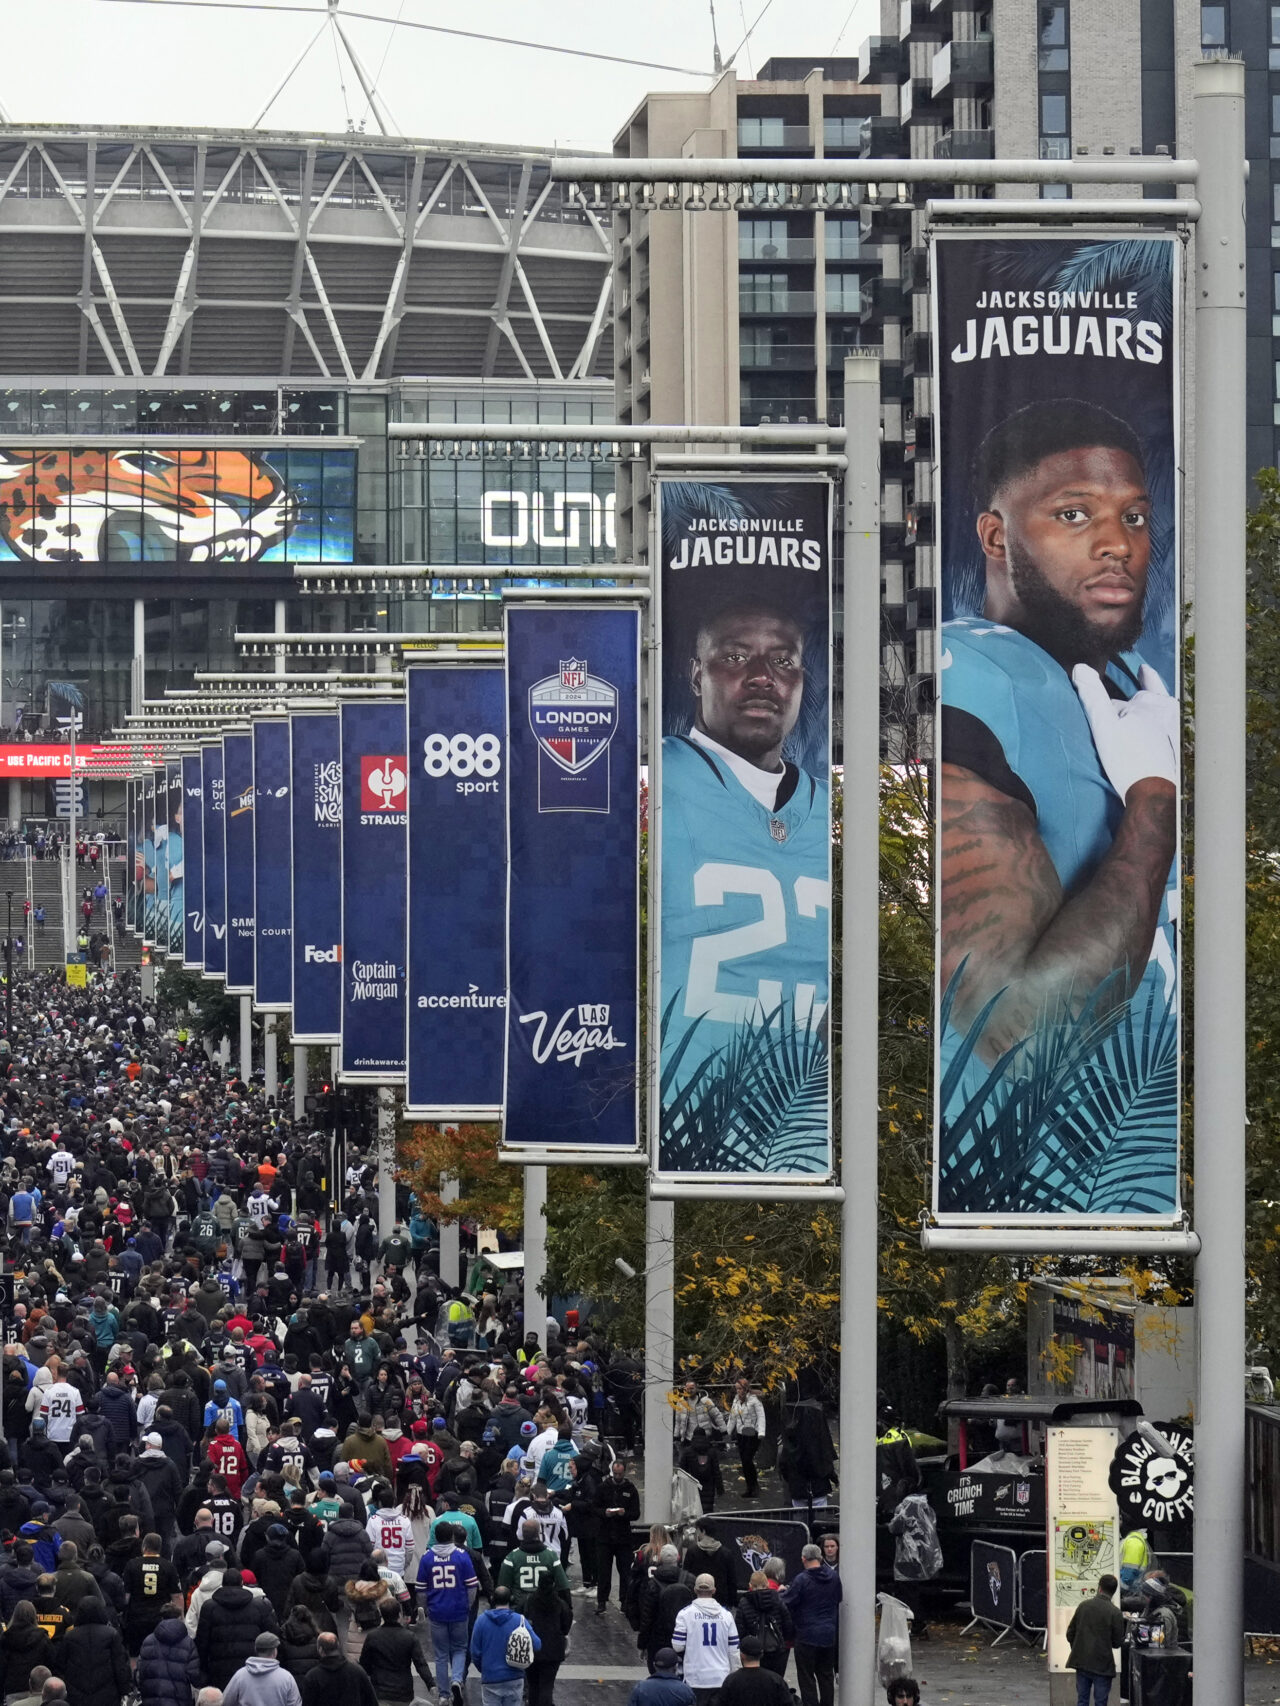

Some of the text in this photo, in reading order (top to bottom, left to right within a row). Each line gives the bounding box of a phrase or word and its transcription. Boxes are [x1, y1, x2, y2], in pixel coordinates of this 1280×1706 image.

[976, 291, 1139, 309] JACKSONVILLE
[951, 316, 1163, 364] JAGUARS
[688, 518, 804, 532] JACKSONVILLE
[670, 536, 821, 571] JAGUARS
[563, 672, 584, 687] NFL
[535, 711, 612, 725] LONDON
[424, 733, 501, 777] 888
[456, 780, 499, 796] sport
[360, 815, 407, 825] STRAUS
[261, 928, 291, 936] COURT
[305, 945, 342, 963] Fed
[352, 960, 396, 982] Captain
[351, 982, 398, 1002] Morgan
[417, 993, 507, 1009] accenture
[581, 1006, 607, 1023] LAS
[519, 1008, 626, 1067] Vegas
[354, 1348, 363, 1363] 2
[51, 1399, 71, 1418] 24
[219, 1455, 238, 1475] 12
[426, 1447, 436, 1465] 6
[960, 1476, 972, 1487] IT'S
[947, 1484, 983, 1504] CRUNCH
[953, 1500, 975, 1517] TIME
[380, 1527, 403, 1549] 85
[144, 1573, 157, 1595] 9
[431, 1565, 456, 1589] 25
[702, 1622, 718, 1646] 11
